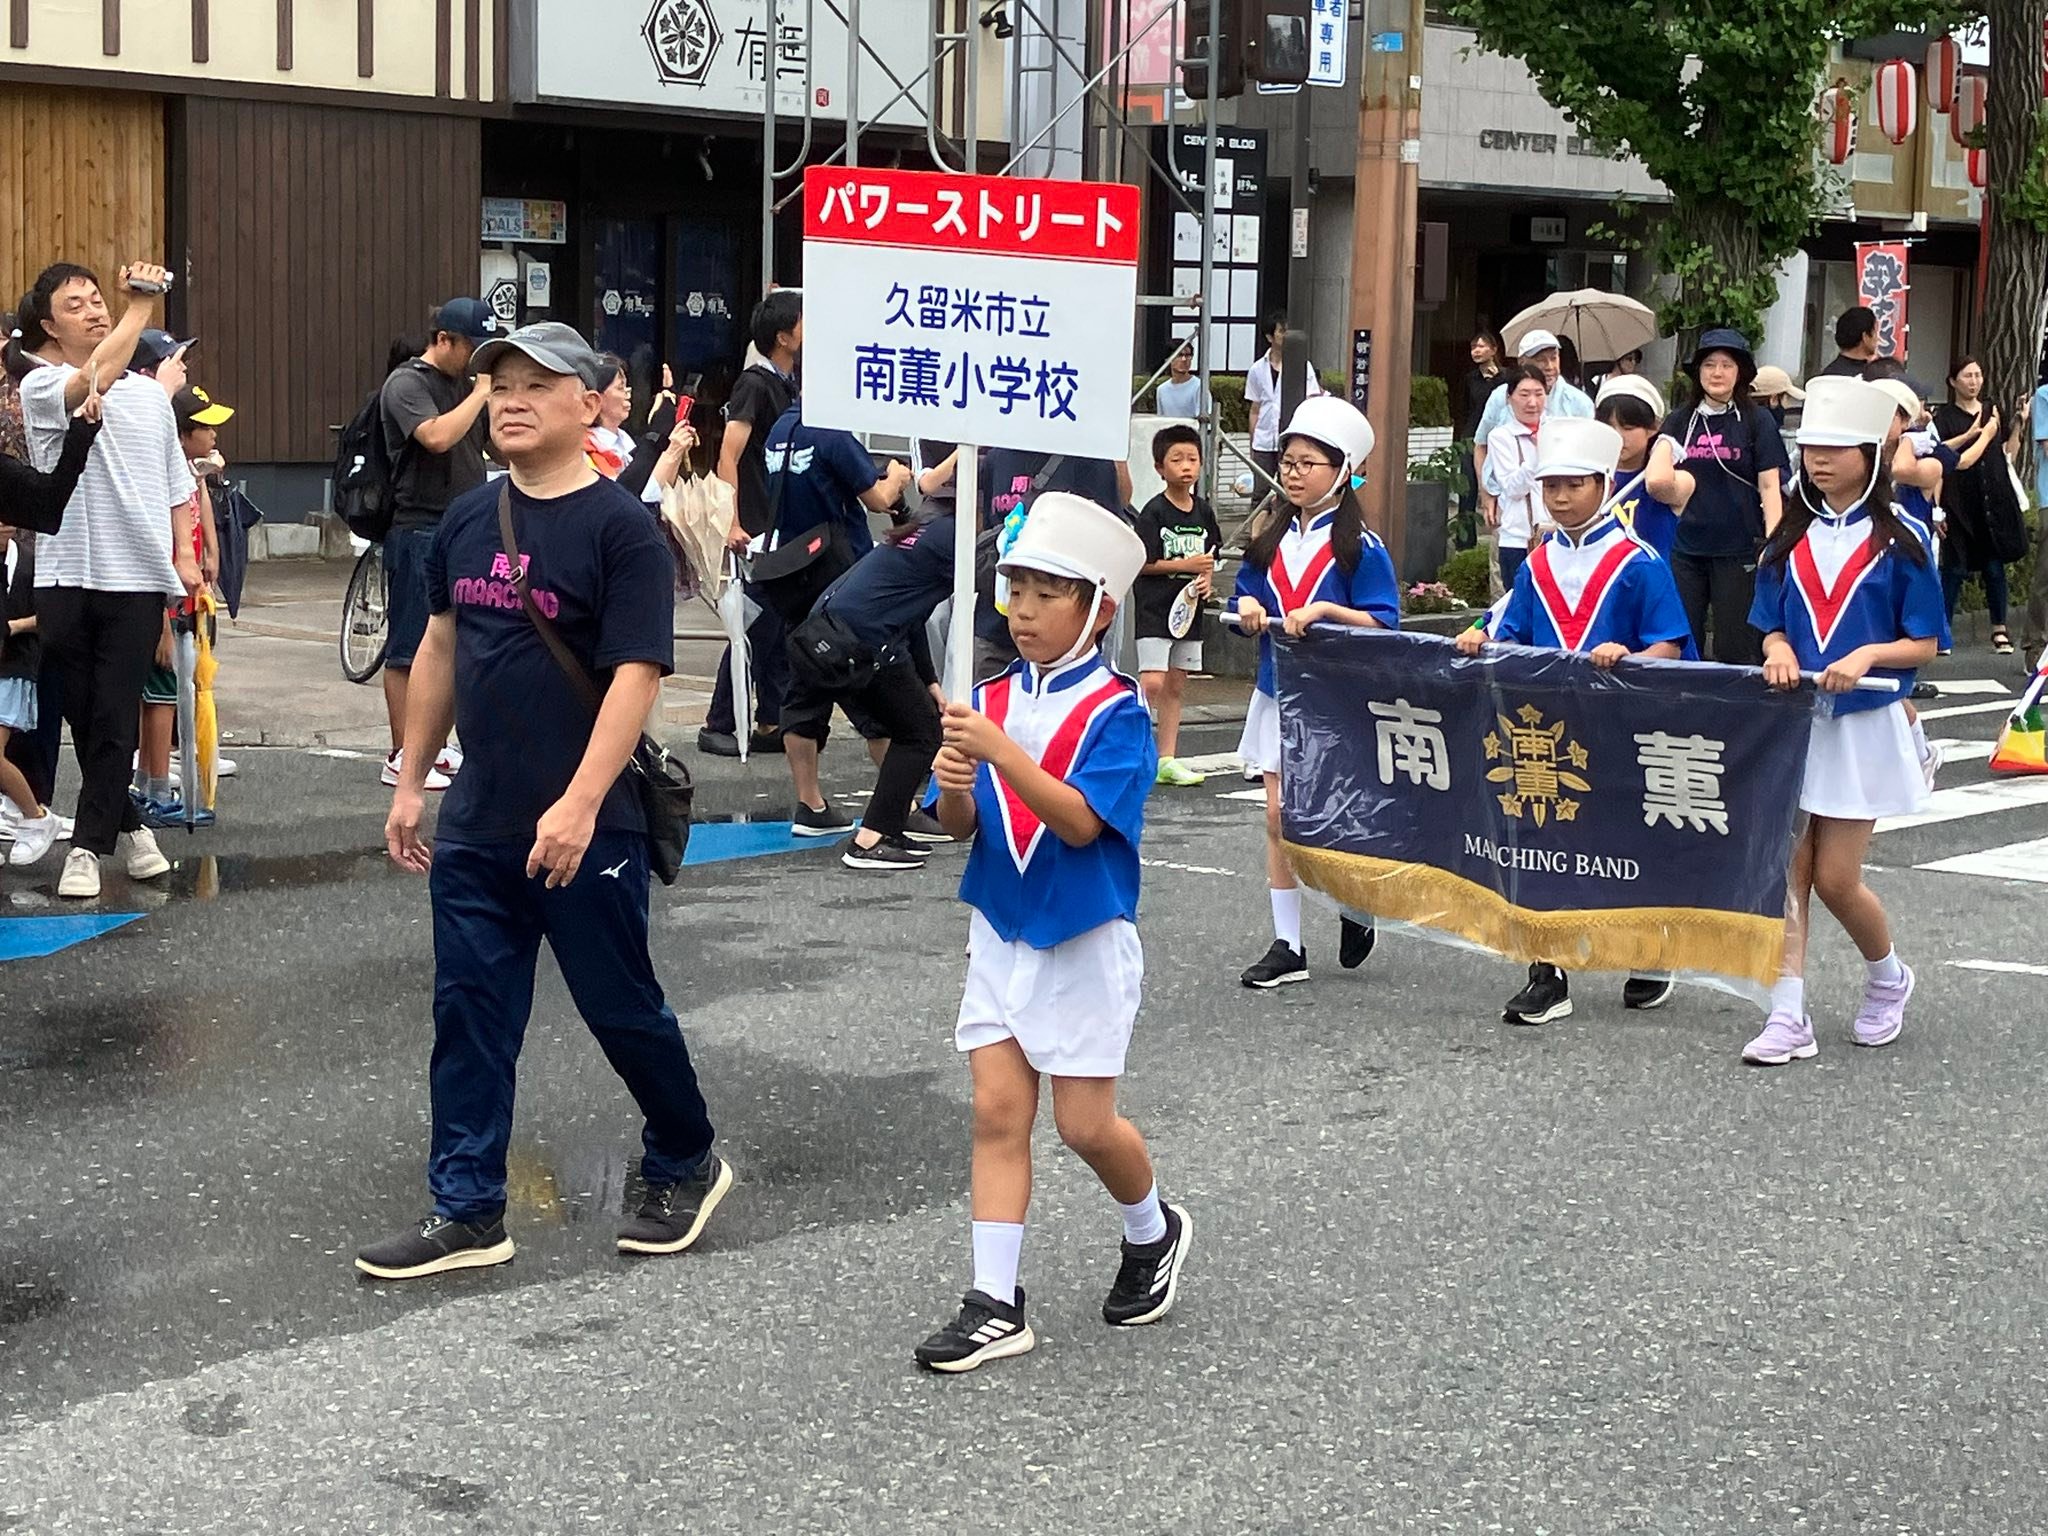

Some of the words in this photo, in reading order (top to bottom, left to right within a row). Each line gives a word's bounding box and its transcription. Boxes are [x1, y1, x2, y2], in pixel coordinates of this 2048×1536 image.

[1319, 22, 1334, 74] 専用
[1183, 134, 1225, 148] CENR
[1480, 129, 1557, 154] CENTER
[819, 181, 1123, 248] パワーストリート
[885, 282, 1050, 338] 久留米市立
[855, 342, 1079, 422] 南薫小学校
[453, 577, 560, 619] MARCNG
[1368, 698, 1450, 791] 南
[1634, 731, 1729, 836] 薫
[1575, 853, 1640, 881] BAND
